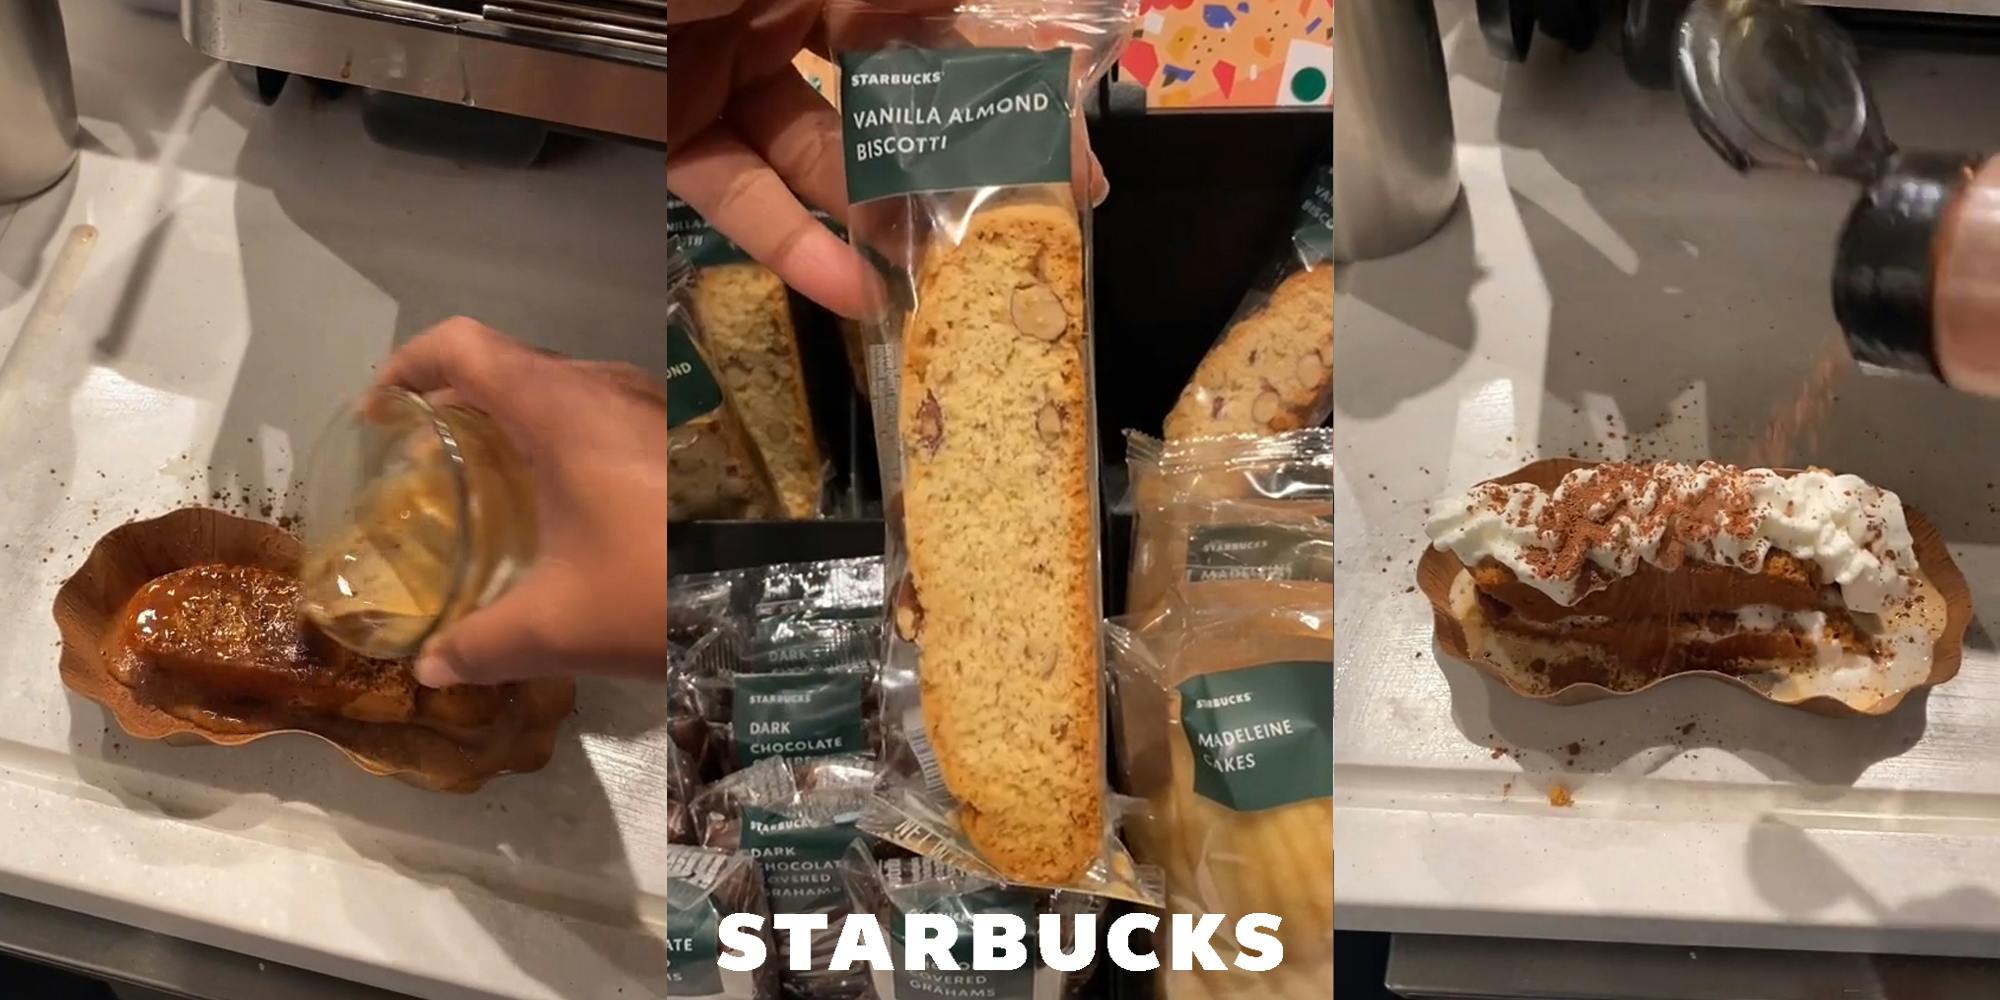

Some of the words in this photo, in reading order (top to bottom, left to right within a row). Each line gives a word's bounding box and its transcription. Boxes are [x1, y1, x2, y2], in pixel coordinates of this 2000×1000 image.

[851, 71, 942, 87] STARBUCKS
[853, 106, 942, 130] VANILLA
[949, 92, 1049, 124] ALMOND
[856, 135, 948, 161] BISCOTTI
[1203, 540, 1268, 553] STARBUCKS
[749, 693, 812, 705] STARBUCKS
[750, 721, 791, 735] DARK
[1198, 719, 1294, 748] MADELEINE
[750, 736, 843, 754] CHOCOLATE
[1202, 752, 1256, 773] CAKES
[750, 846, 797, 859] DARK
[761, 859, 848, 873] HOCOLAT
[767, 873, 832, 885] OVERED
[909, 979, 996, 998] GRAHAMS
